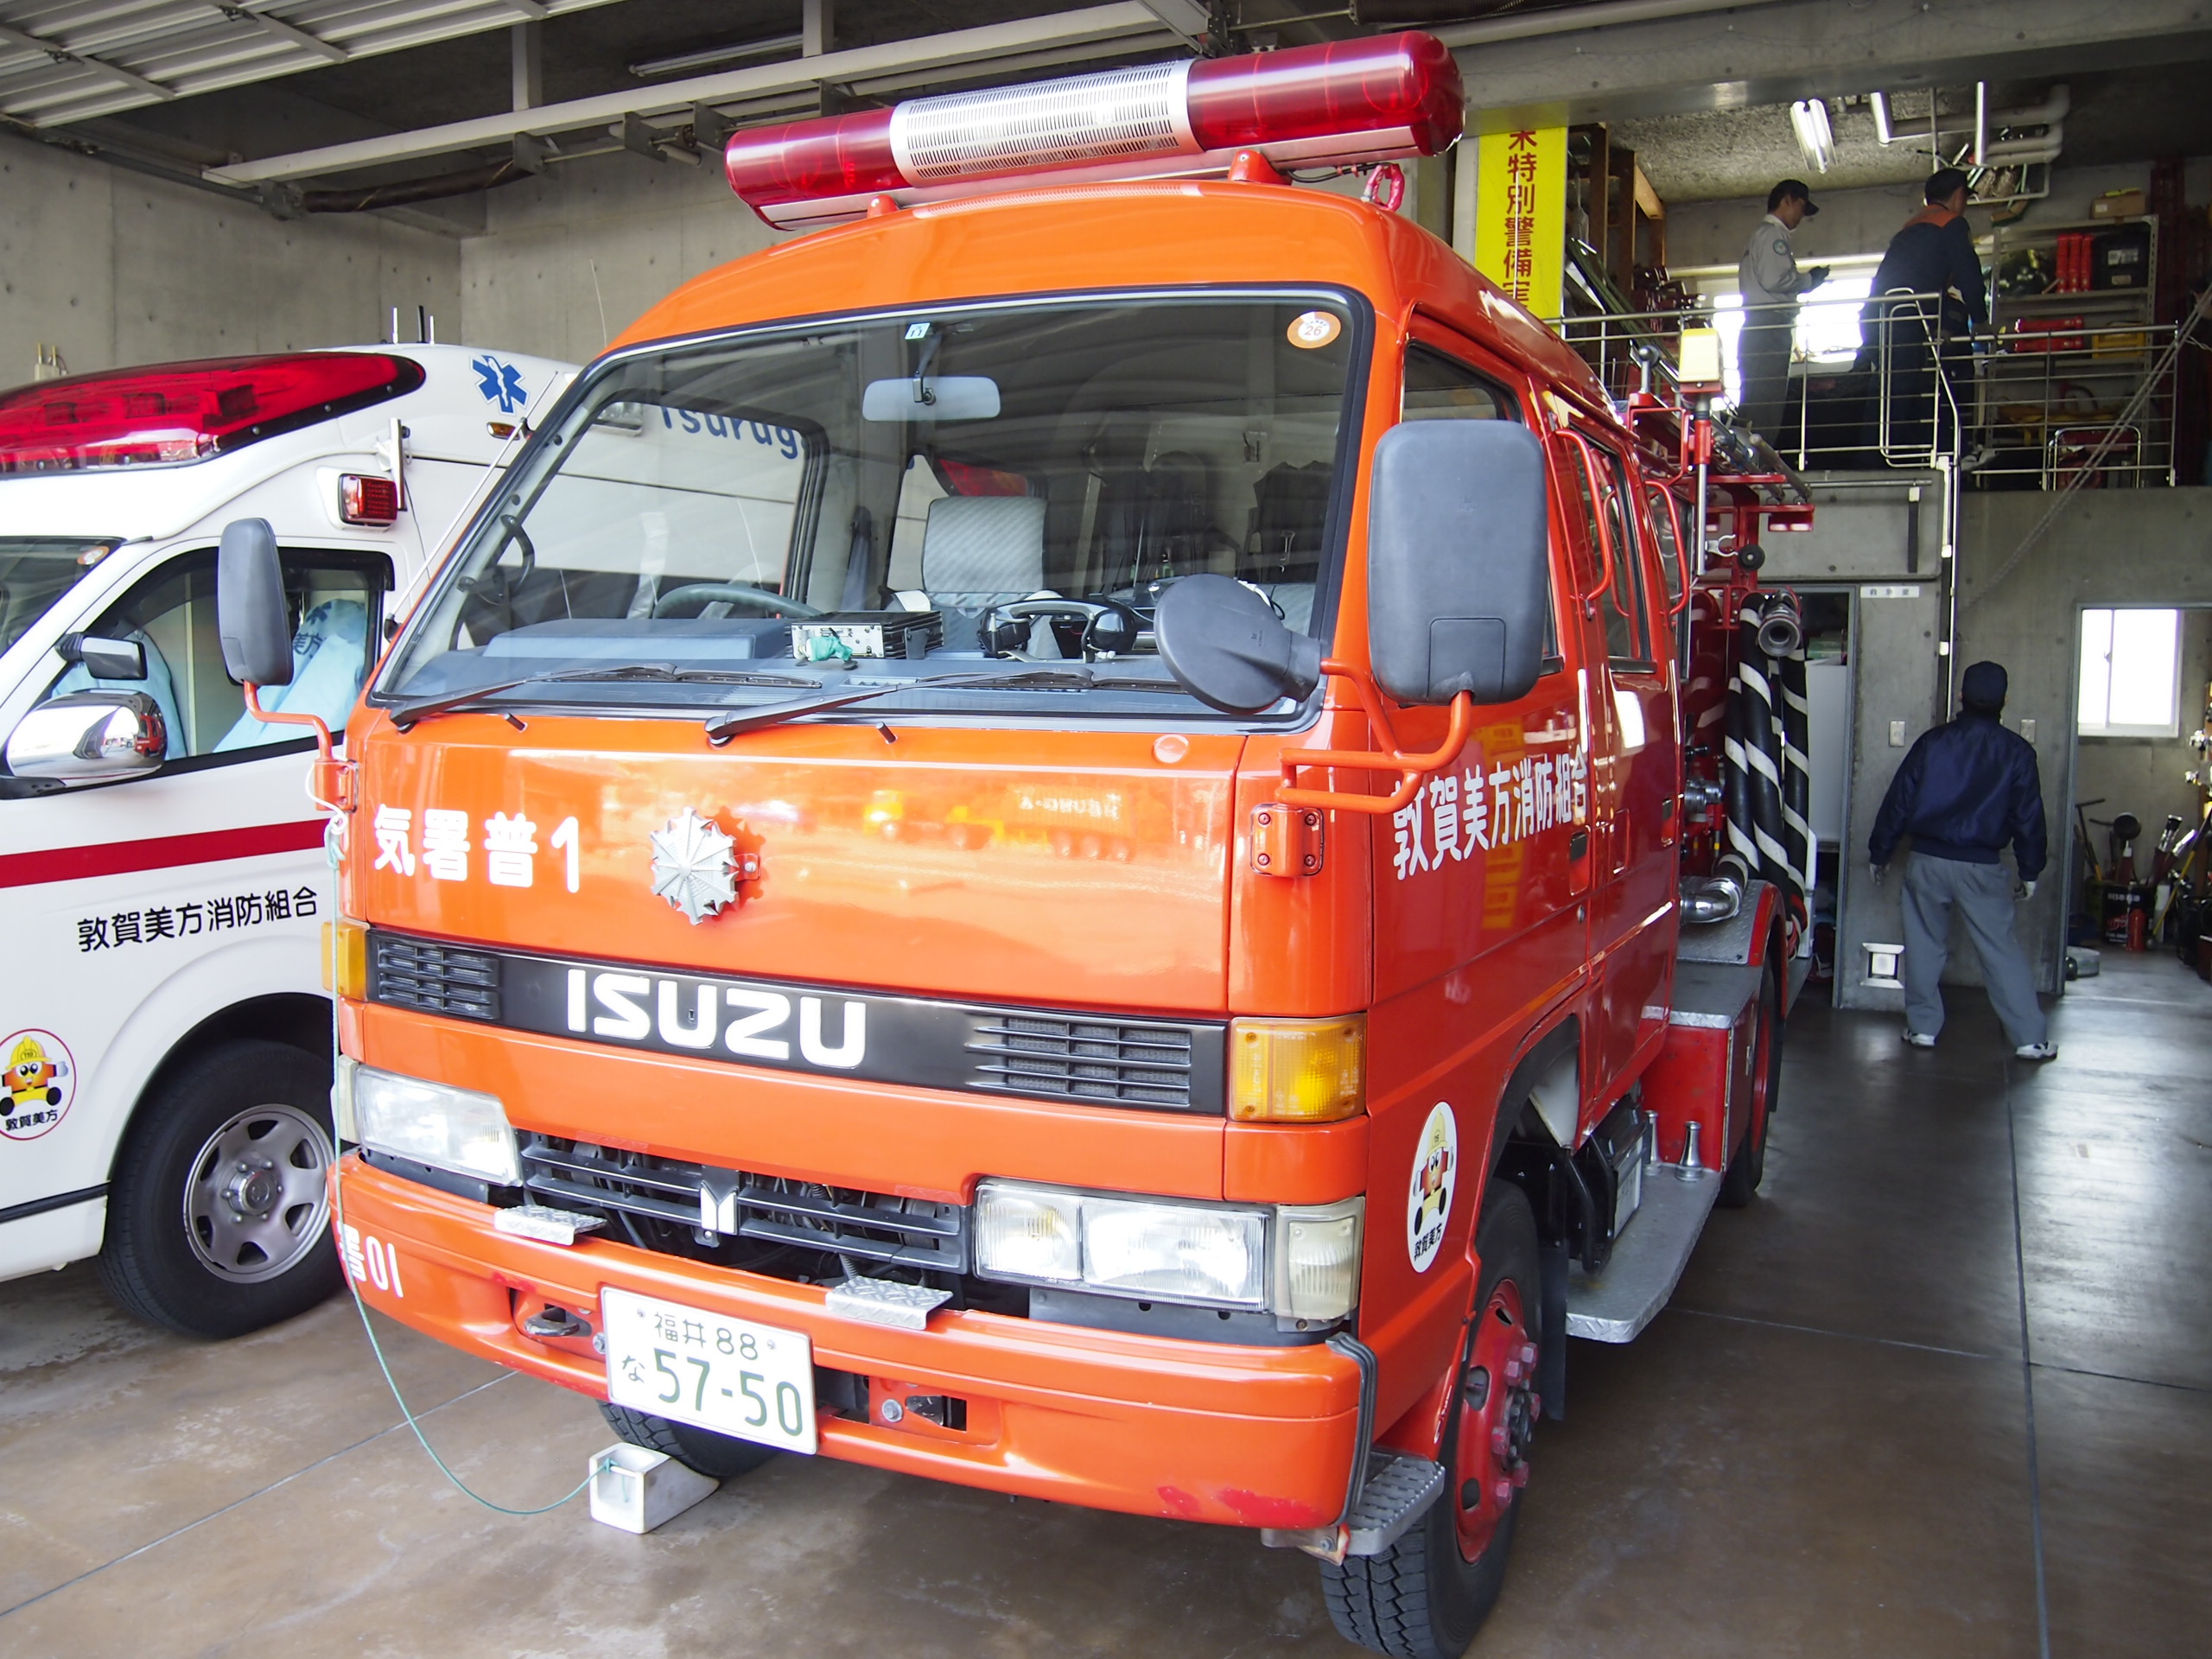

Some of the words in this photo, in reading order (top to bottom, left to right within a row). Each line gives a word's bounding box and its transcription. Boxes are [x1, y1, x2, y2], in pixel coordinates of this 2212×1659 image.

[1304, 325, 1323, 336] 26
[1390, 744, 1588, 880] 敦賀美方消防組合
[77, 886, 317, 952] 敦賀美方消防組合
[568, 968, 867, 1070] ISUZU
[5, 1109, 58, 1131] 敦賀美方
[1414, 1223, 1442, 1261] 敦賀美方
[621, 1355, 645, 1383] な
[654, 1347, 803, 1436] 57-50
